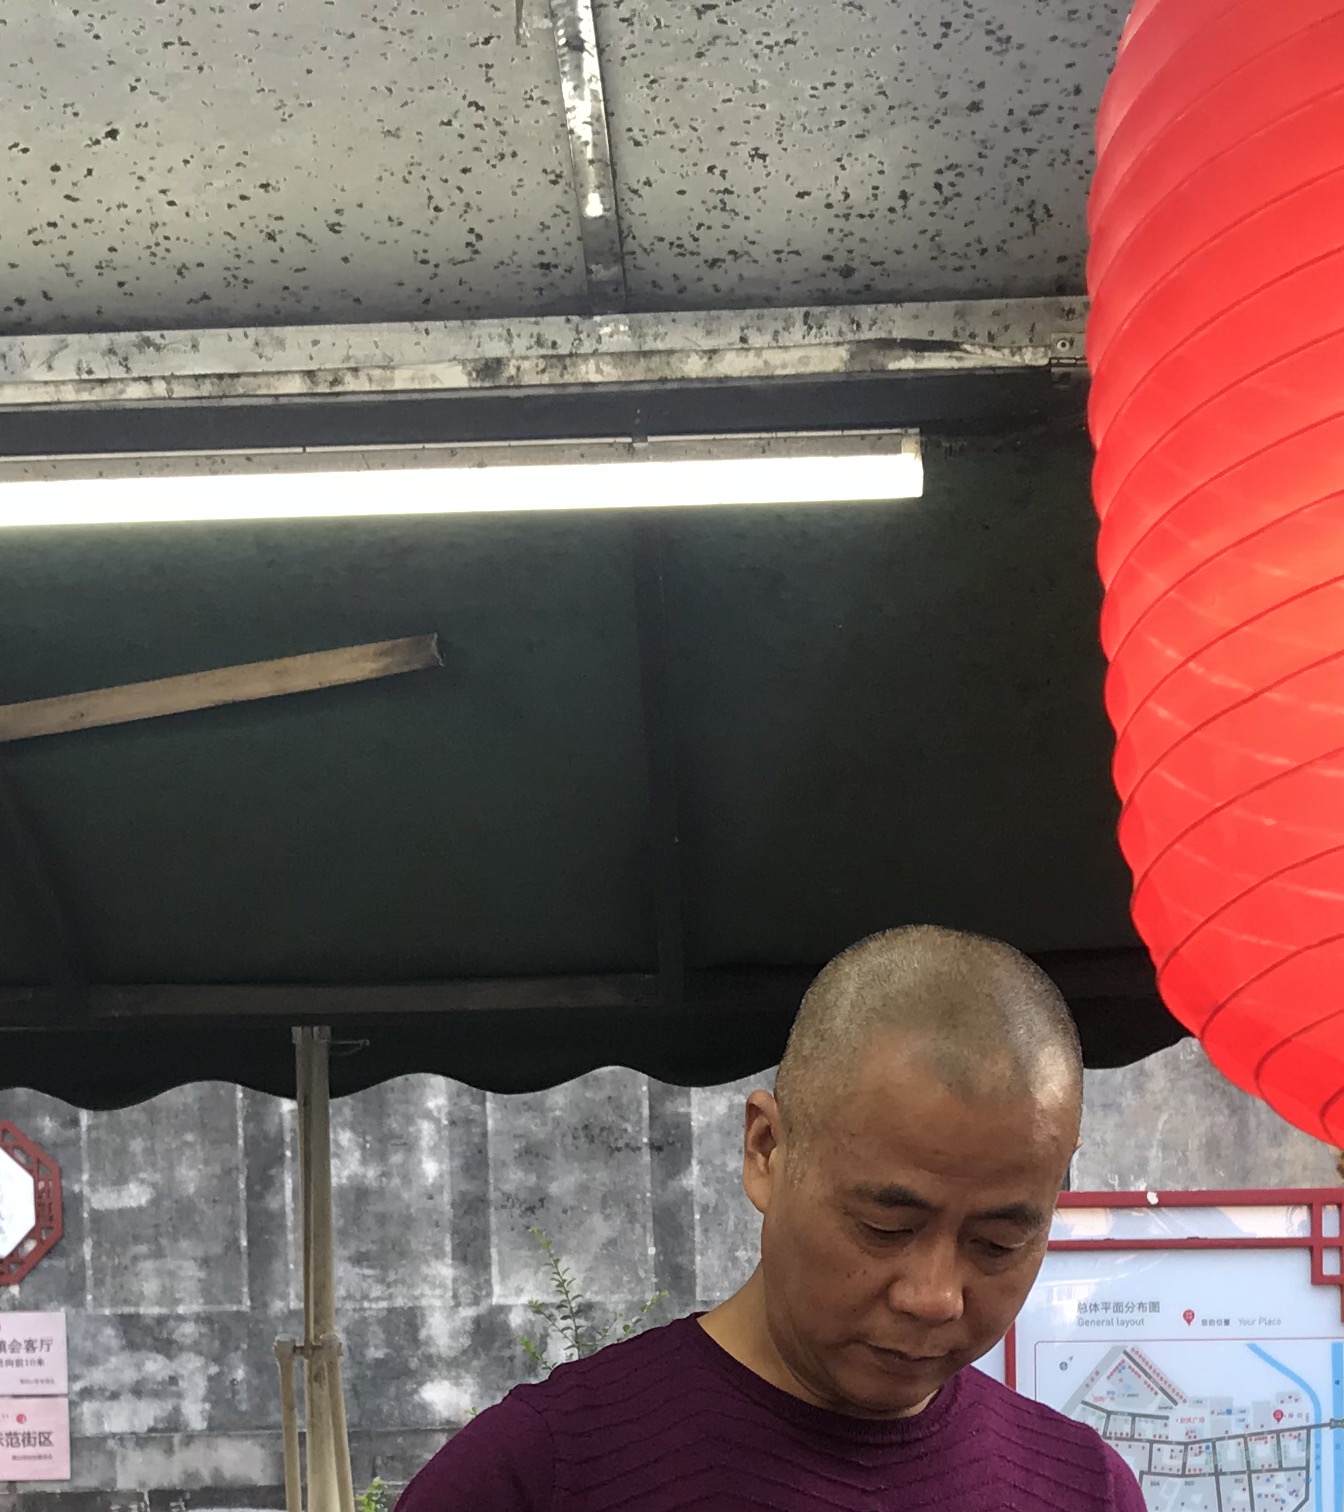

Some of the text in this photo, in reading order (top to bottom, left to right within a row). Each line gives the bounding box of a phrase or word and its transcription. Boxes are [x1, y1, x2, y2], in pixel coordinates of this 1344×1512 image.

[1077, 1317, 1145, 1328] General layout
[1238, 1318, 1256, 1327] Your
